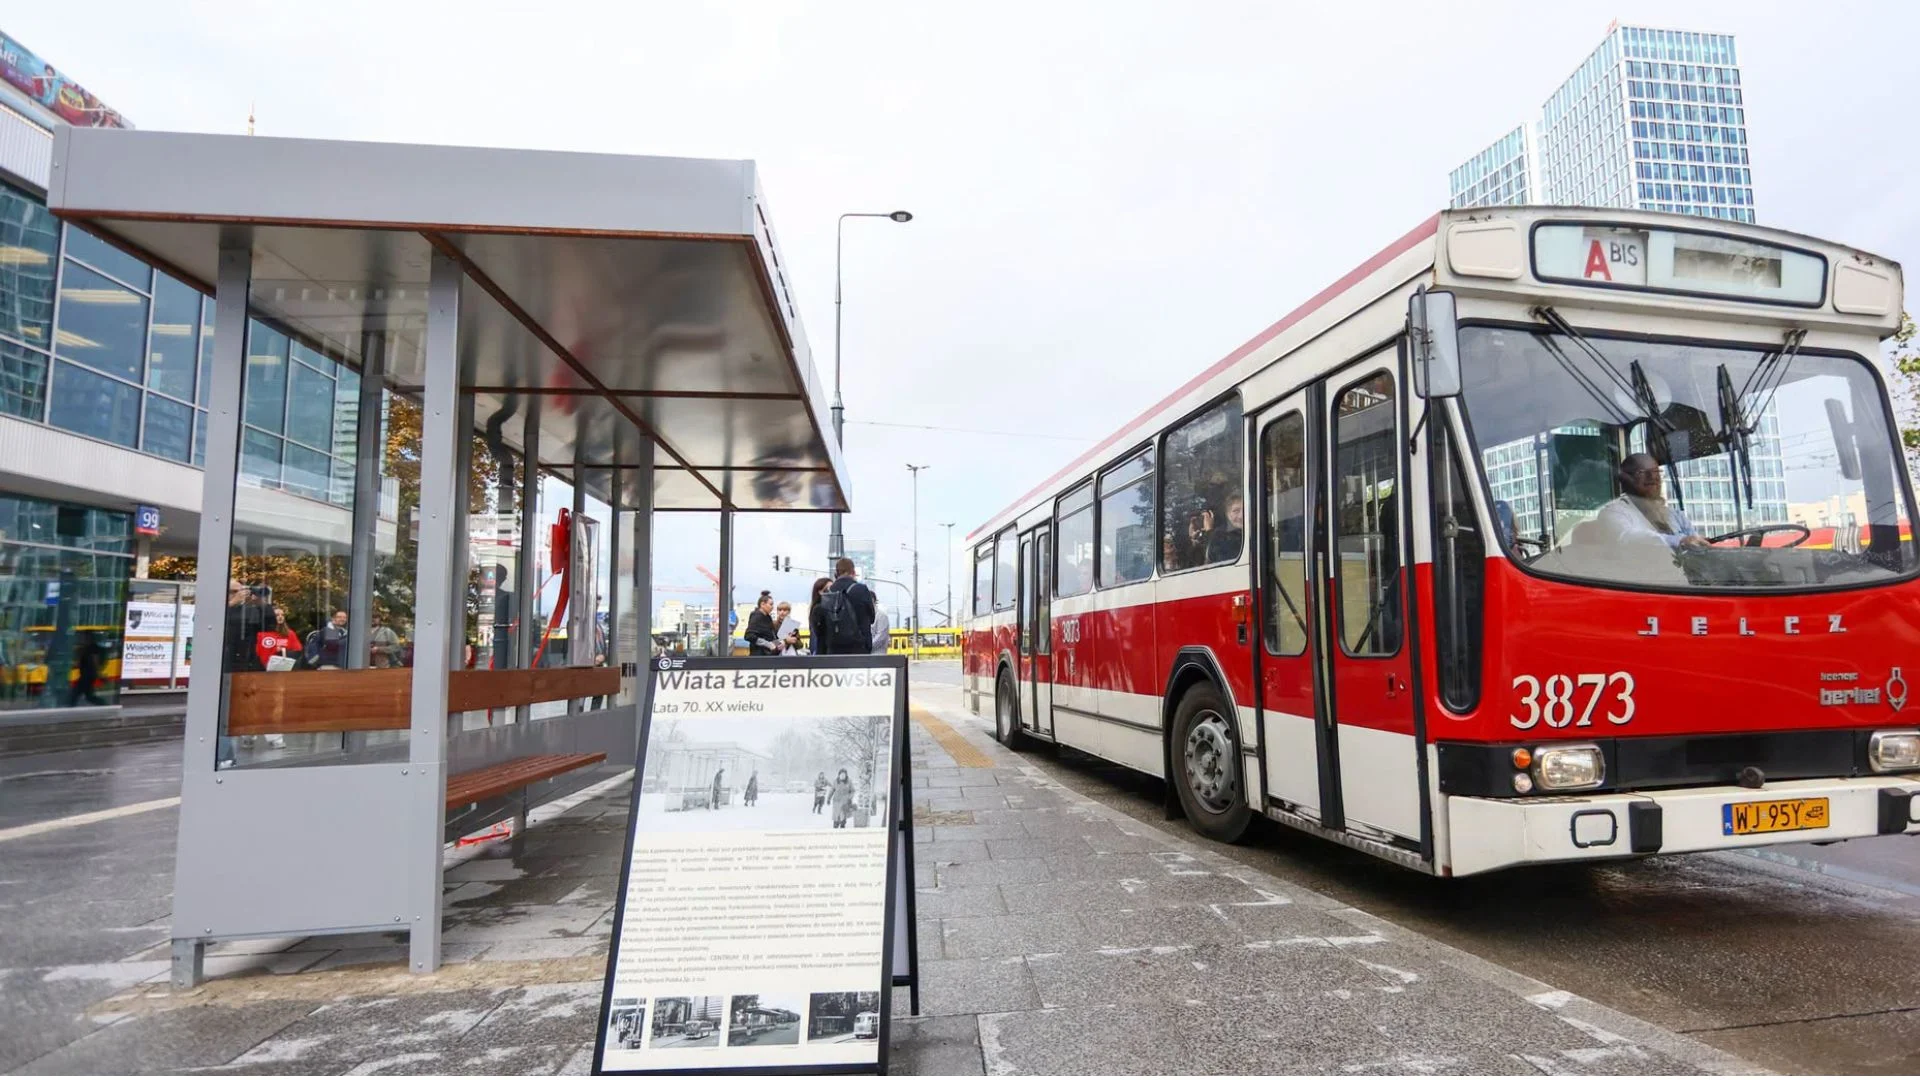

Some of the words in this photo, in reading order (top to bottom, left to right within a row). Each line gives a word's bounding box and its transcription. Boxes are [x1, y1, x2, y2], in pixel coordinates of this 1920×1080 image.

[1584, 239, 1612, 281] A
[1610, 241, 1638, 266] BIS
[143, 512, 158, 528] 99
[1062, 618, 1080, 642] 3873
[1637, 614, 1847, 636] JELCZ
[659, 670, 726, 690] Wiata
[732, 668, 892, 689] Łazienkowska
[652, 702, 679, 714] Lata
[683, 702, 701, 713] 70.
[705, 701, 724, 712] XX
[727, 700, 764, 712] wieku
[1510, 671, 1636, 729] 3873
[1736, 805, 1760, 829] WJ
[1769, 803, 1801, 828] 95Y
